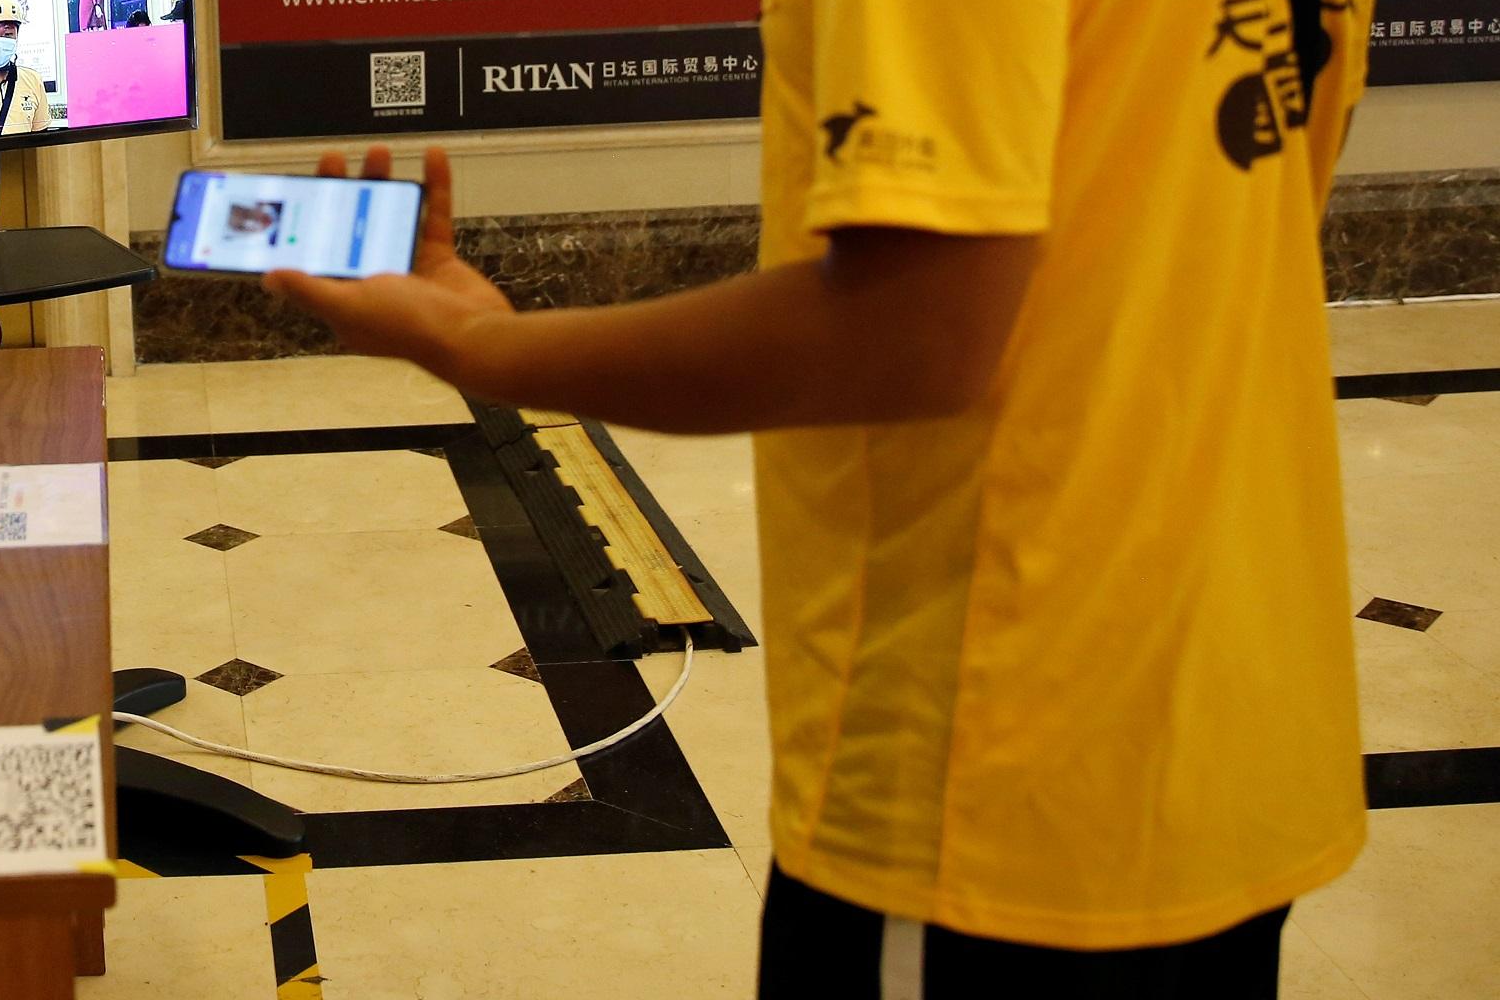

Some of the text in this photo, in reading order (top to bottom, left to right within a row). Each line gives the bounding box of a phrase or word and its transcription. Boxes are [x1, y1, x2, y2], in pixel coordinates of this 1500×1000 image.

[602, 55, 758, 78] 日坛国际贸易中心
[603, 72, 757, 88] RITAN INTERNATION TRADE CENTER
